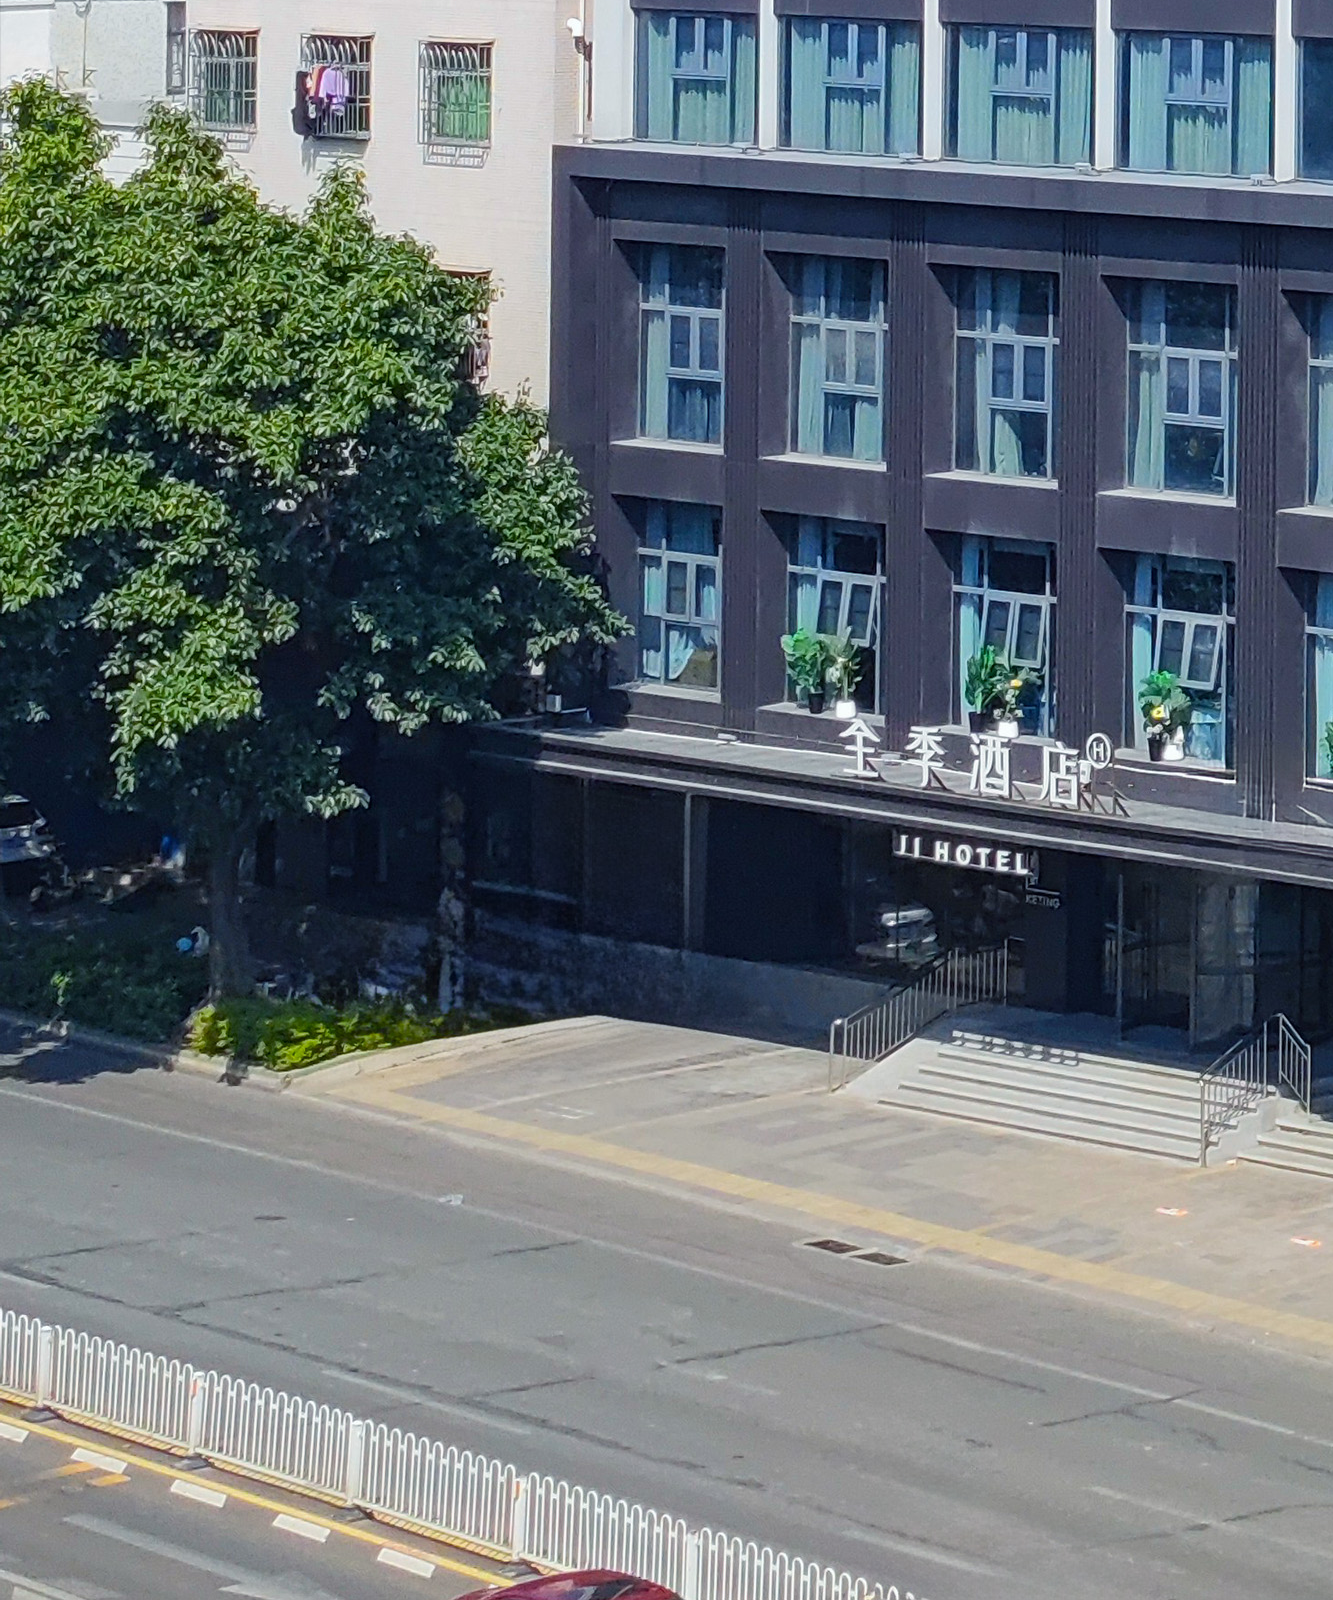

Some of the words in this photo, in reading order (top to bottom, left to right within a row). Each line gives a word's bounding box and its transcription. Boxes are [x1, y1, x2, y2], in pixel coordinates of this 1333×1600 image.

[839, 718, 1081, 809] 全季酒店
[898, 834, 921, 859] JI
[933, 840, 1029, 875] HOTEL
